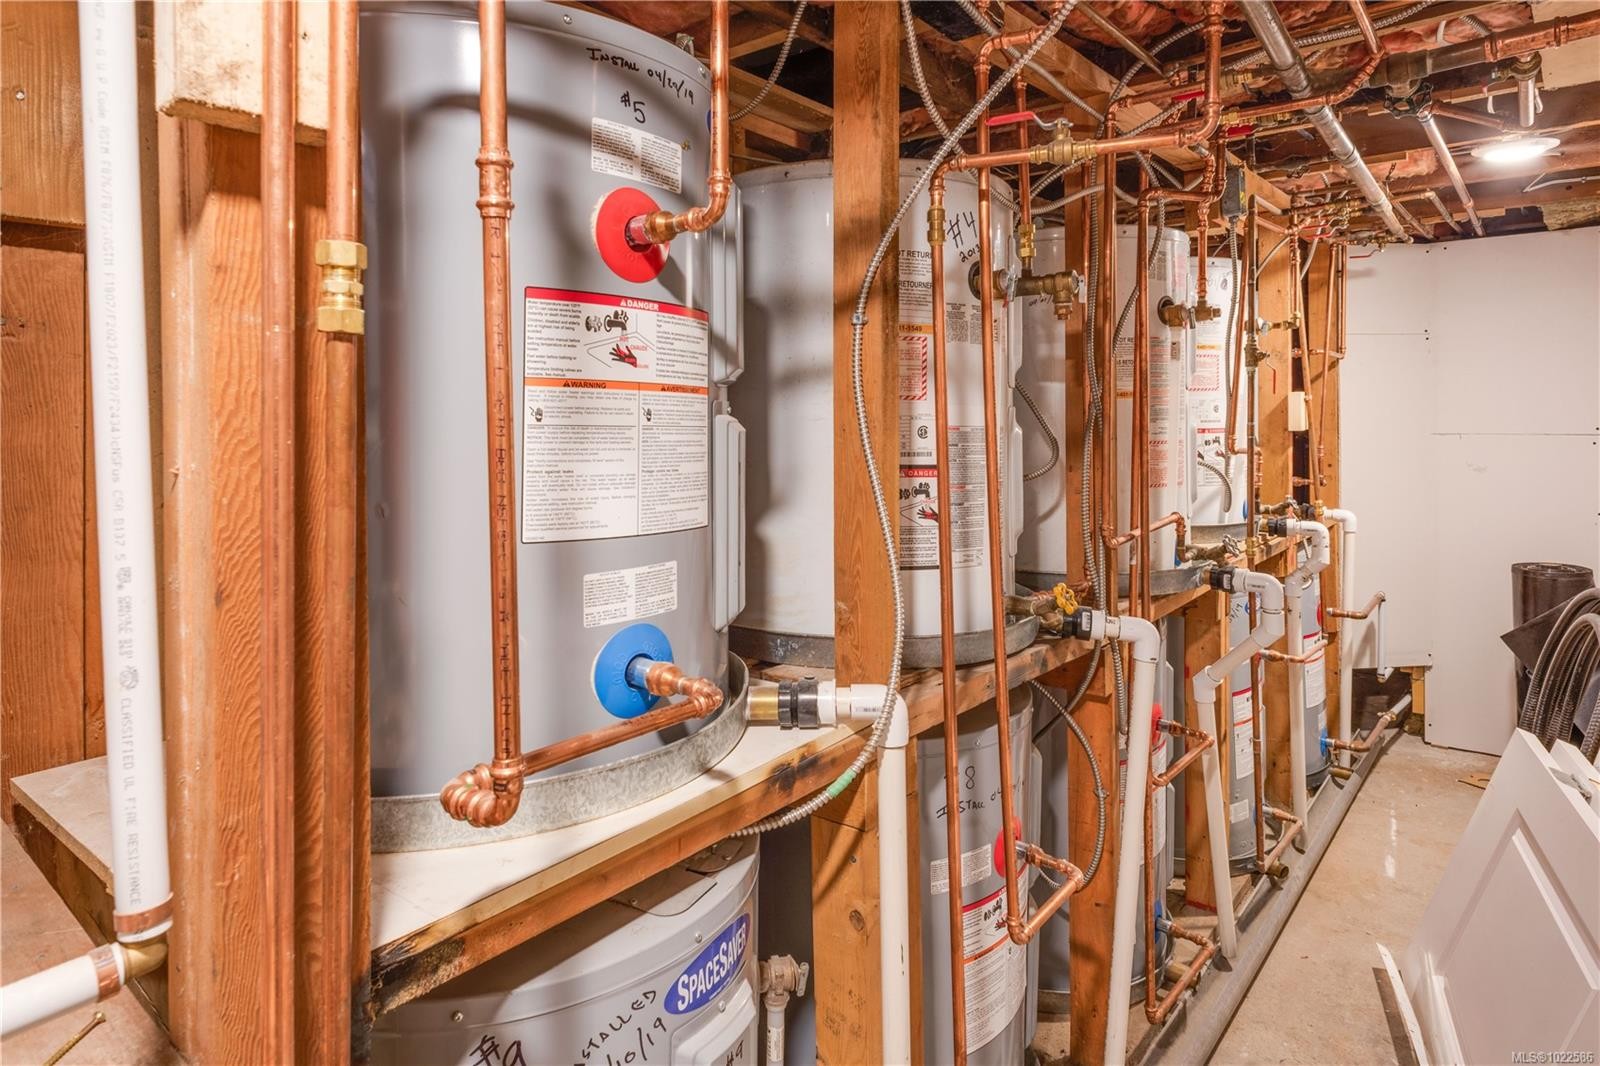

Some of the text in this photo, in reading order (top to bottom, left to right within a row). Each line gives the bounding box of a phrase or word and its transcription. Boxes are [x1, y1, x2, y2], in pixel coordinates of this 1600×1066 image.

[946, 211, 978, 249] #4
[907, 250, 932, 259] RETUR
[627, 301, 660, 311] DANGER
[570, 381, 607, 390] WARNING
[120, 697, 134, 769] CLASSIFIED
[126, 832, 141, 906] RESISTANCE
